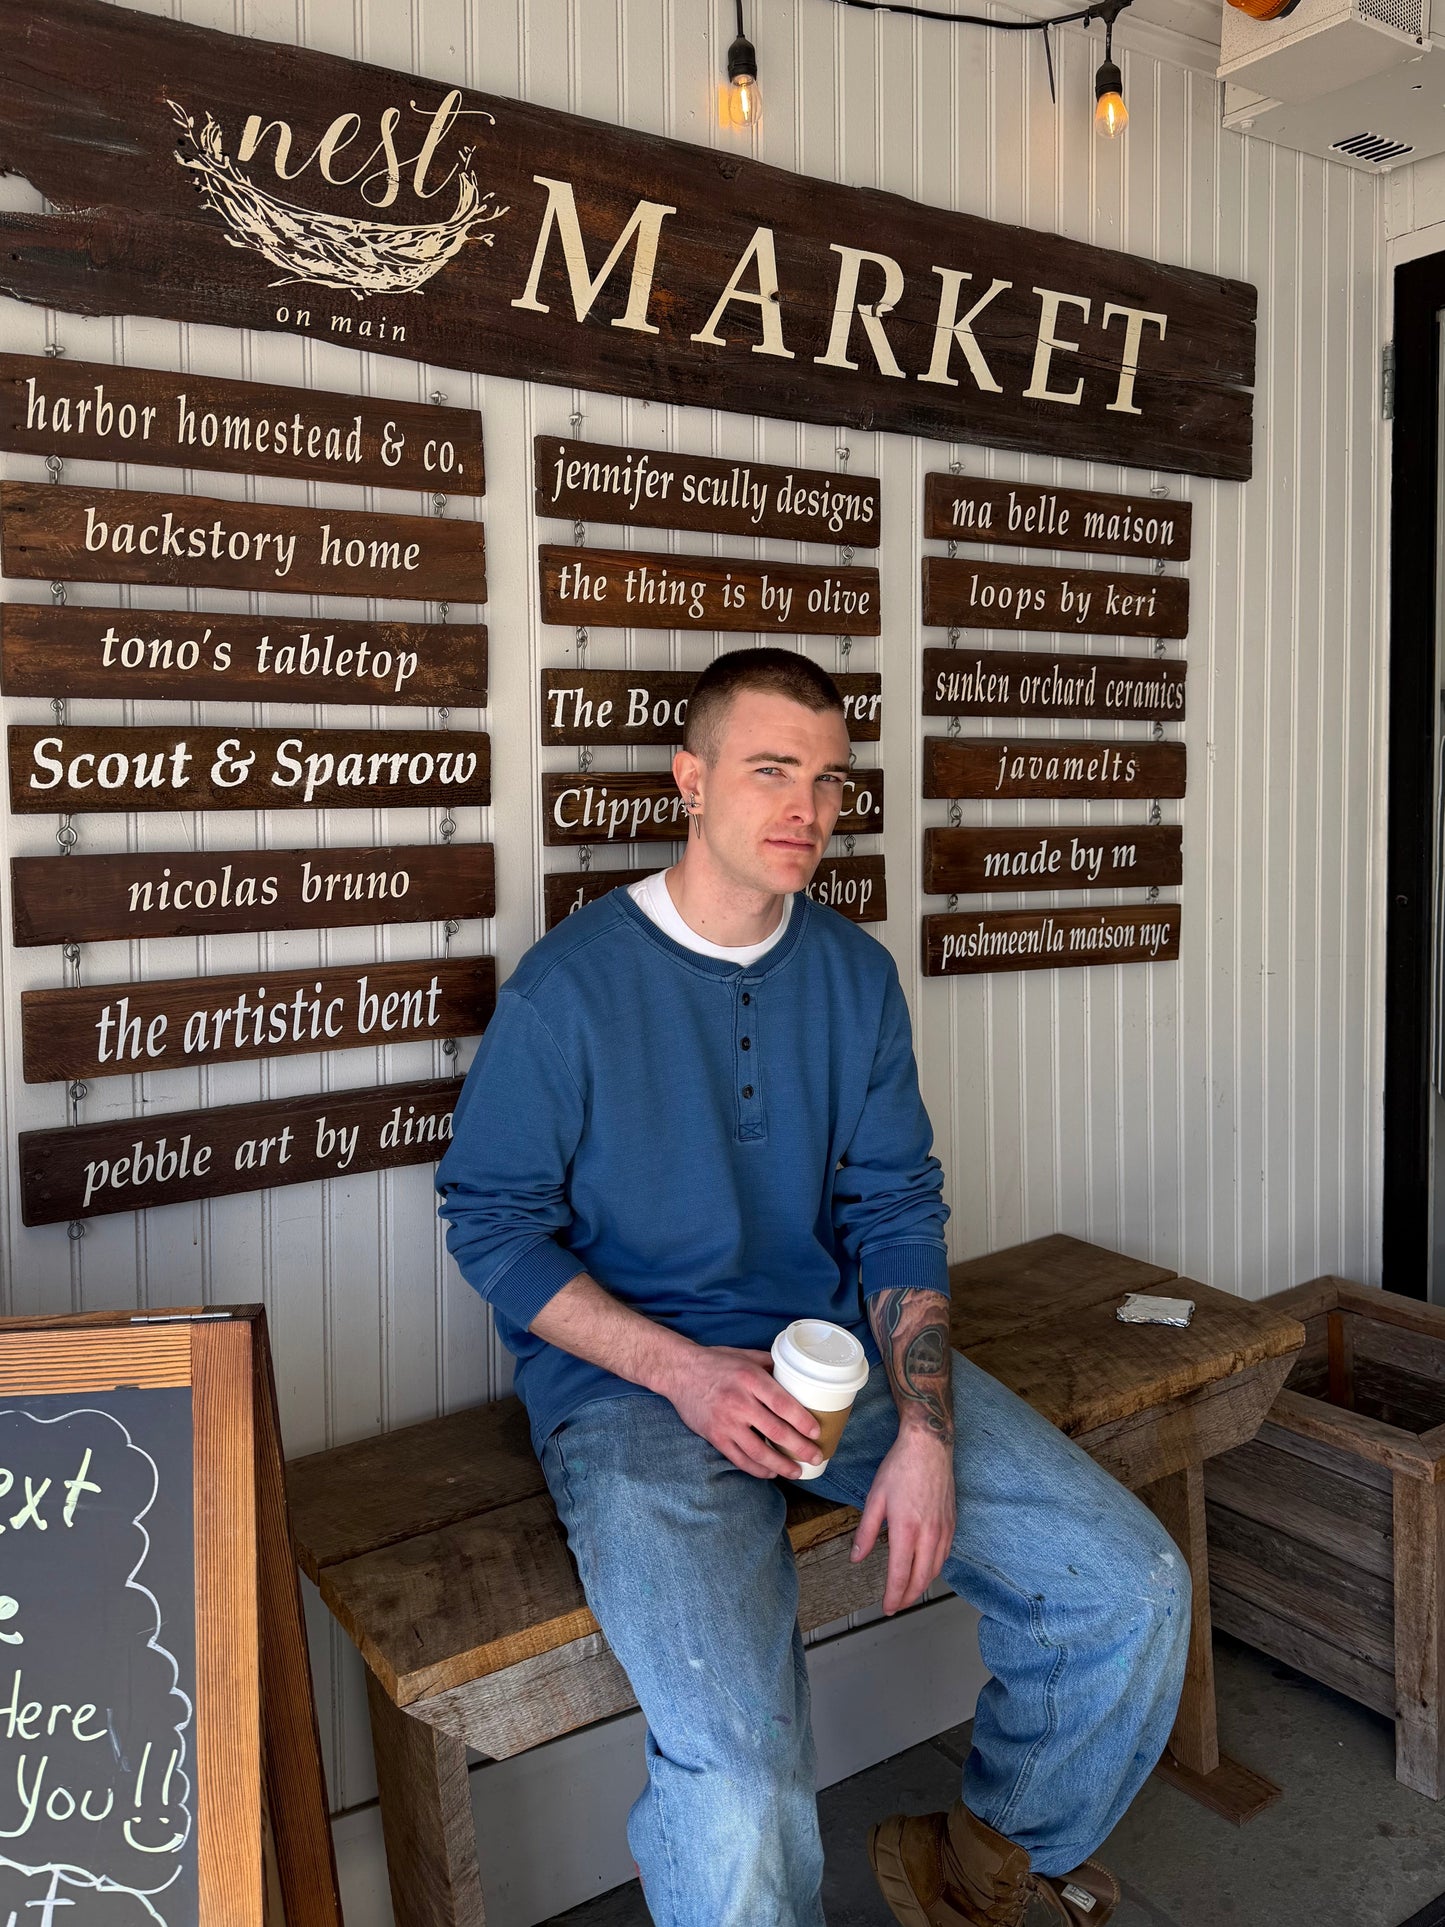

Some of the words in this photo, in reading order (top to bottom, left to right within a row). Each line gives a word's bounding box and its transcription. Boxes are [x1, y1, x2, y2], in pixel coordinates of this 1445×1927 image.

[238, 89, 495, 208] nest
[277, 307, 310, 326] on
[332, 316, 405, 341] main
[511, 176, 1167, 414] MARKET
[26, 378, 155, 439] harbor
[177, 394, 362, 463] homestead
[381, 422, 404, 466] &
[424, 440, 463, 474] co.
[552, 446, 673, 510] jennifer
[683, 468, 767, 523] scully
[777, 475, 873, 532] designs
[952, 499, 992, 528] ma
[1009, 492, 1069, 535] belle
[1084, 512, 1173, 545] maison
[84, 507, 295, 576] backstory
[321, 525, 419, 570] home
[558, 563, 606, 601] the
[625, 567, 706, 618] thing
[722, 574, 744, 608] is
[761, 575, 792, 622] by
[808, 579, 869, 614] olive
[971, 575, 1045, 619] loops
[1061, 582, 1091, 623] by
[1106, 585, 1156, 616] keri
[101, 628, 231, 670] tono's
[256, 634, 417, 692] tabletop
[936, 661, 1009, 702] sunken
[1020, 664, 1096, 705] orchard
[1106, 681, 1182, 708] ceramics
[548, 688, 612, 727] The
[30, 738, 192, 789] Scout
[211, 739, 255, 787] &
[271, 739, 476, 802] Sparrow
[996, 746, 1135, 790] javamelts
[128, 865, 277, 911] nicolas
[301, 862, 409, 902] bruno
[984, 840, 1061, 876] made
[1071, 838, 1103, 880] by
[1112, 845, 1136, 867] m
[942, 919, 1064, 969] pashmeen/la
[1070, 918, 1134, 950] maison
[1140, 924, 1169, 956] nyc
[96, 997, 167, 1062] the
[184, 982, 343, 1053] artistic
[357, 976, 442, 1033] bent
[83, 1137, 211, 1207] pebble
[235, 1126, 294, 1170] art
[316, 1117, 359, 1168] by
